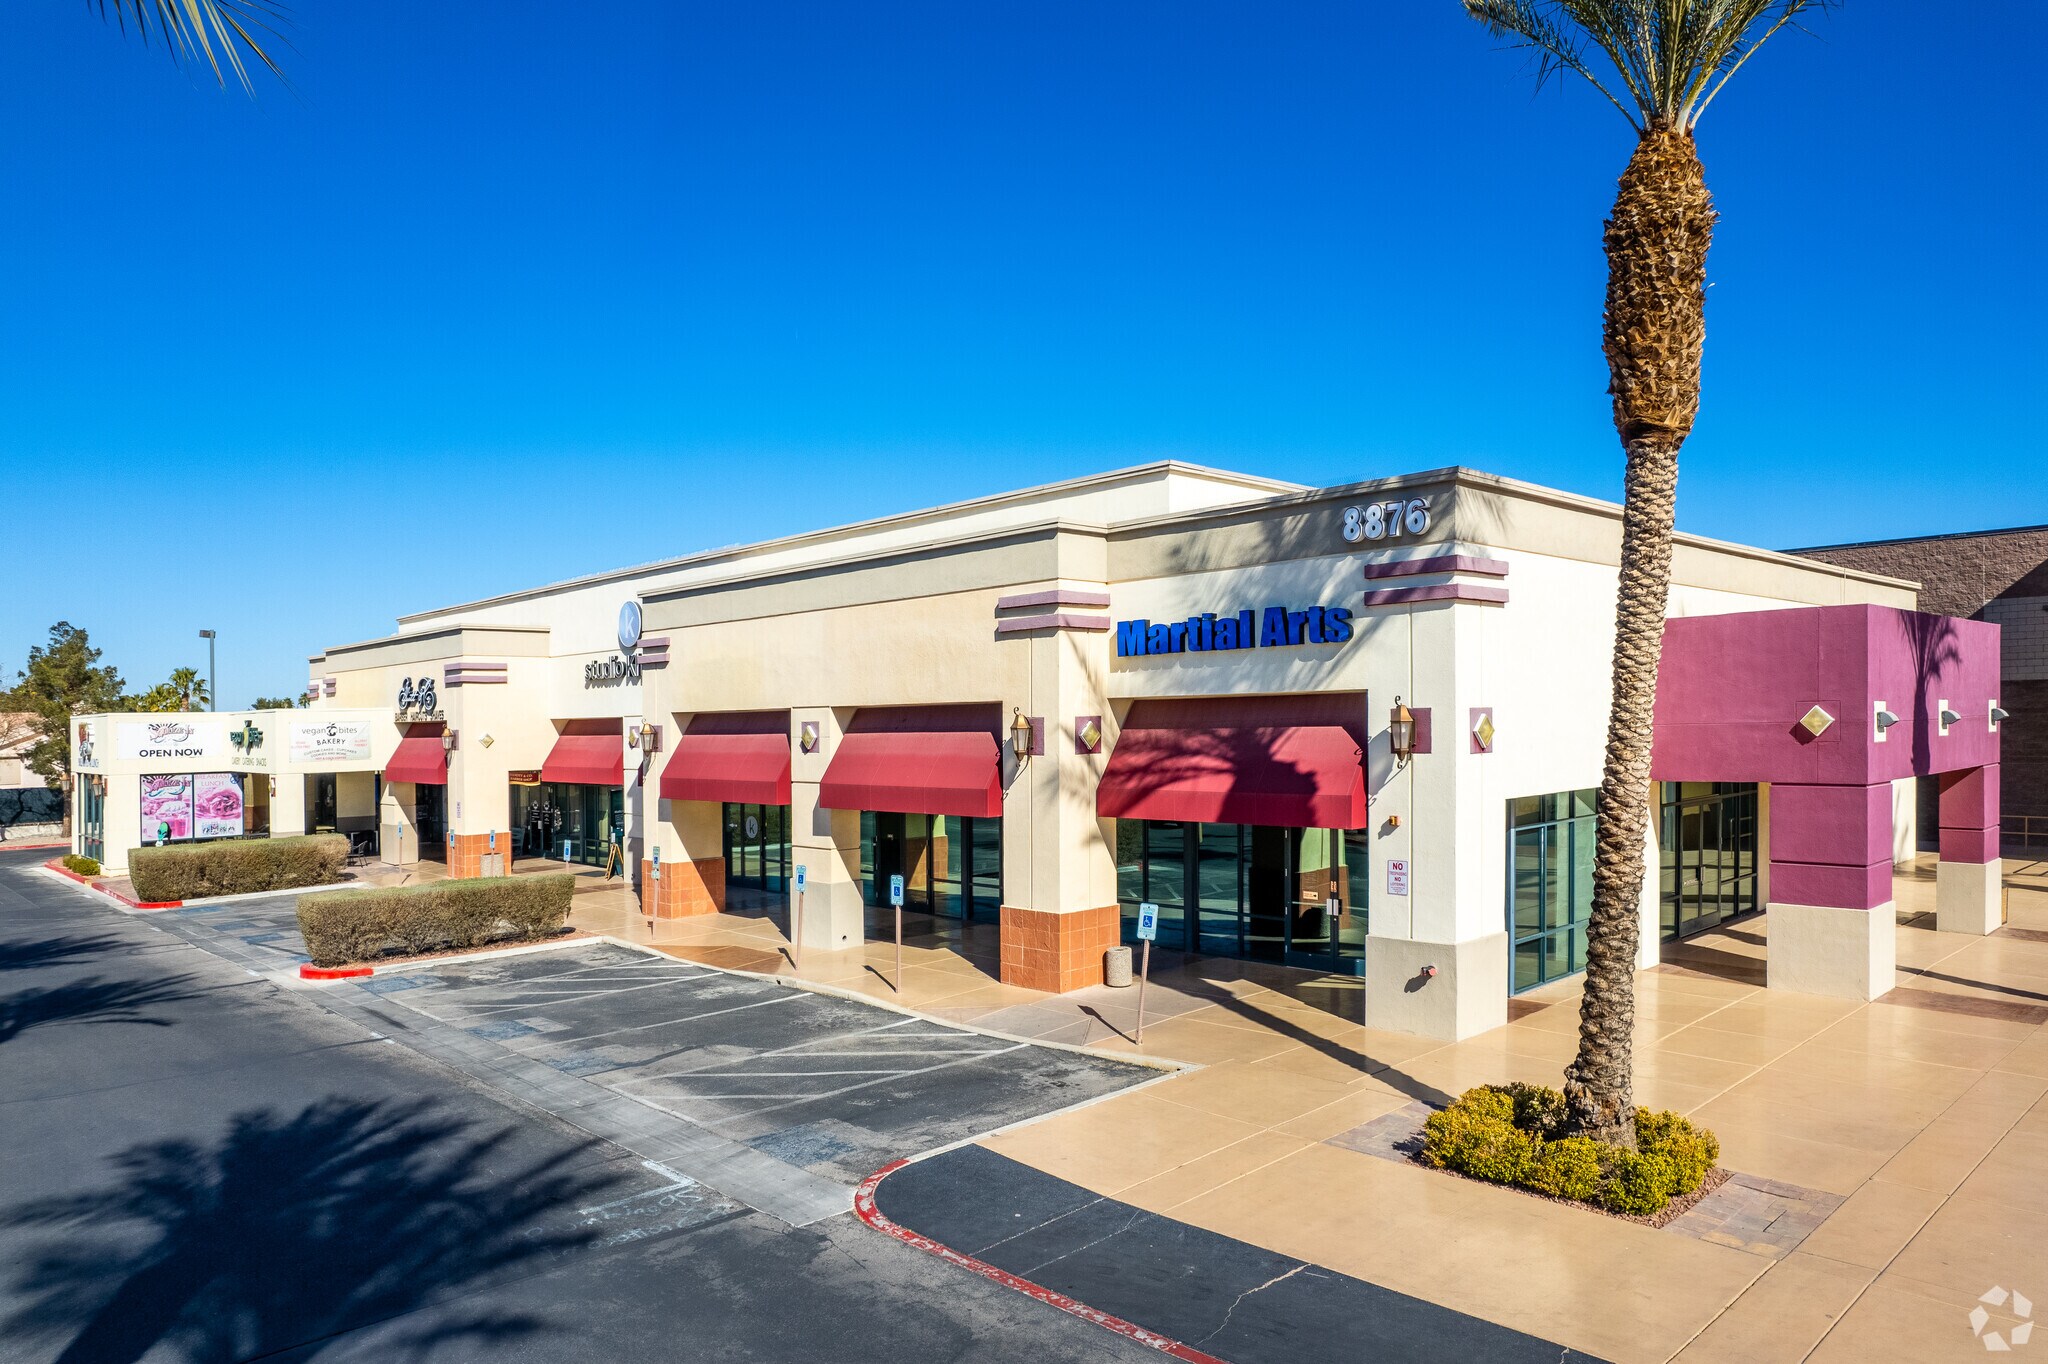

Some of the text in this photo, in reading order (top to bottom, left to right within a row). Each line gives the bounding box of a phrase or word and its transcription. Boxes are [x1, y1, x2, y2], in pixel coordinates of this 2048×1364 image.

[1342, 497, 1430, 543] 8876
[1117, 605, 1354, 658] Martial Arts
[584, 655, 625, 681] studio
[301, 726, 358, 736] vegan bites
[316, 738, 346, 746] BAKERY
[139, 748, 203, 758] OPEN NOW
